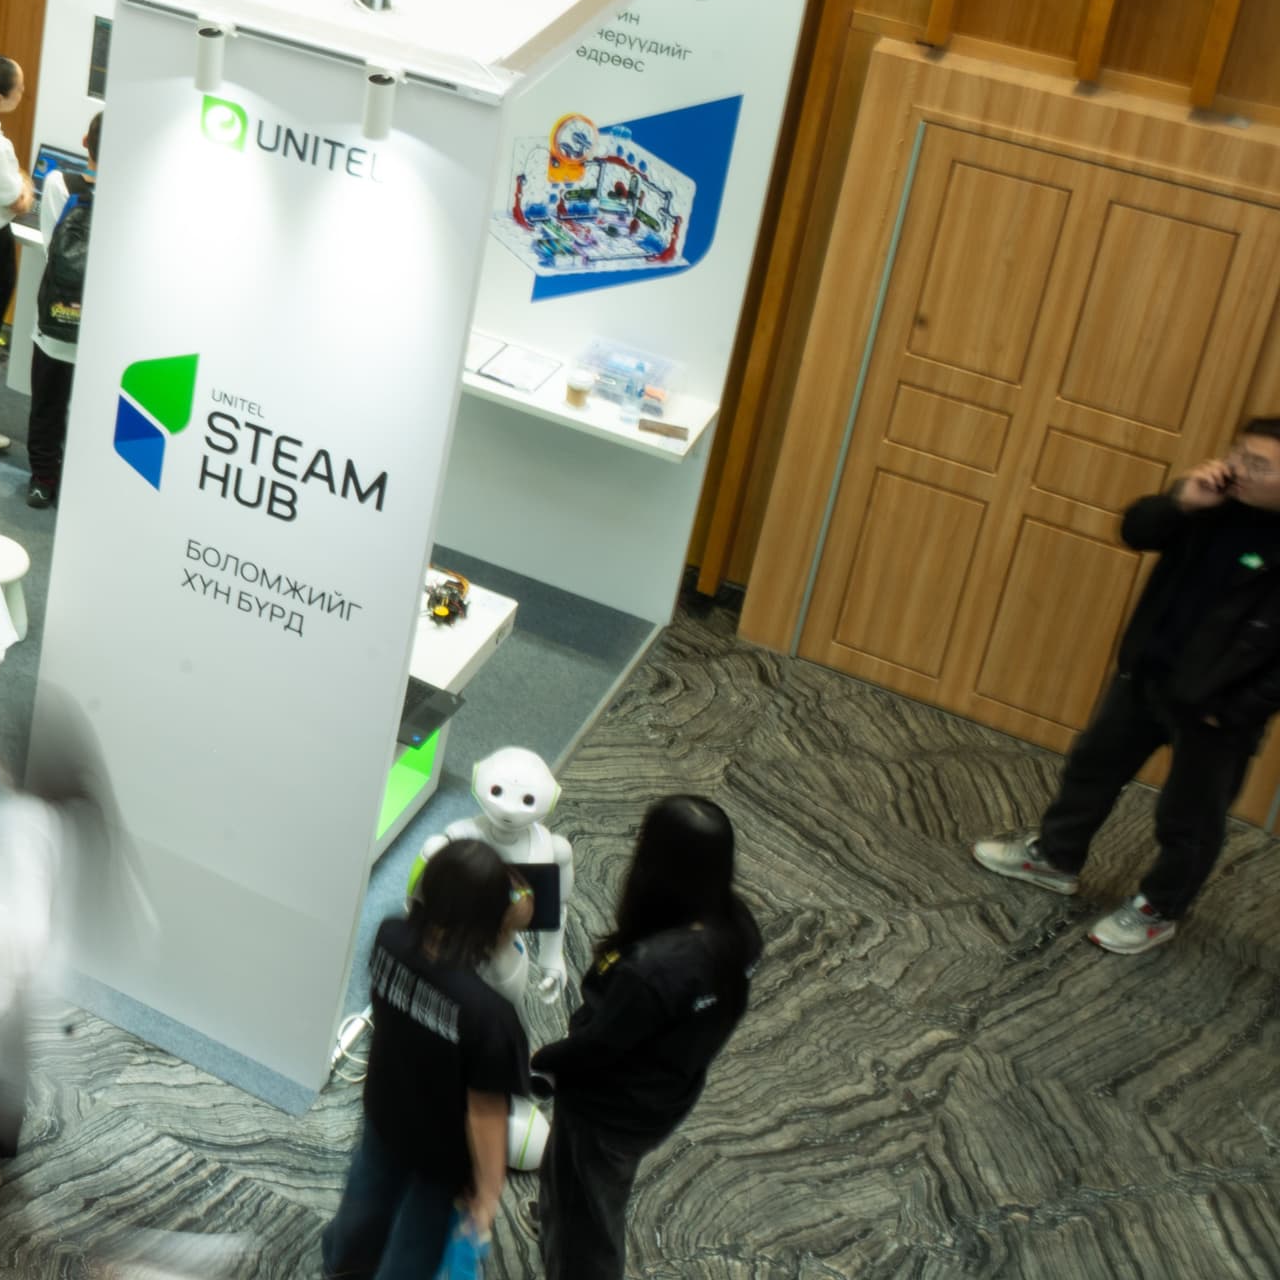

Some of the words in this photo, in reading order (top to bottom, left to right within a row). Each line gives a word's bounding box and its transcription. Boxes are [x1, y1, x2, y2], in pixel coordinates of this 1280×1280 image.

[255, 119, 384, 184] UNITEL
[211, 389, 265, 419] UNITEL
[198, 455, 297, 522] HUB
[204, 410, 388, 512] STEAM
[181, 568, 231, 605] ХҮН
[237, 590, 304, 638] БҮРД
[186, 539, 362, 622] БОЛОМЖИЙГ
